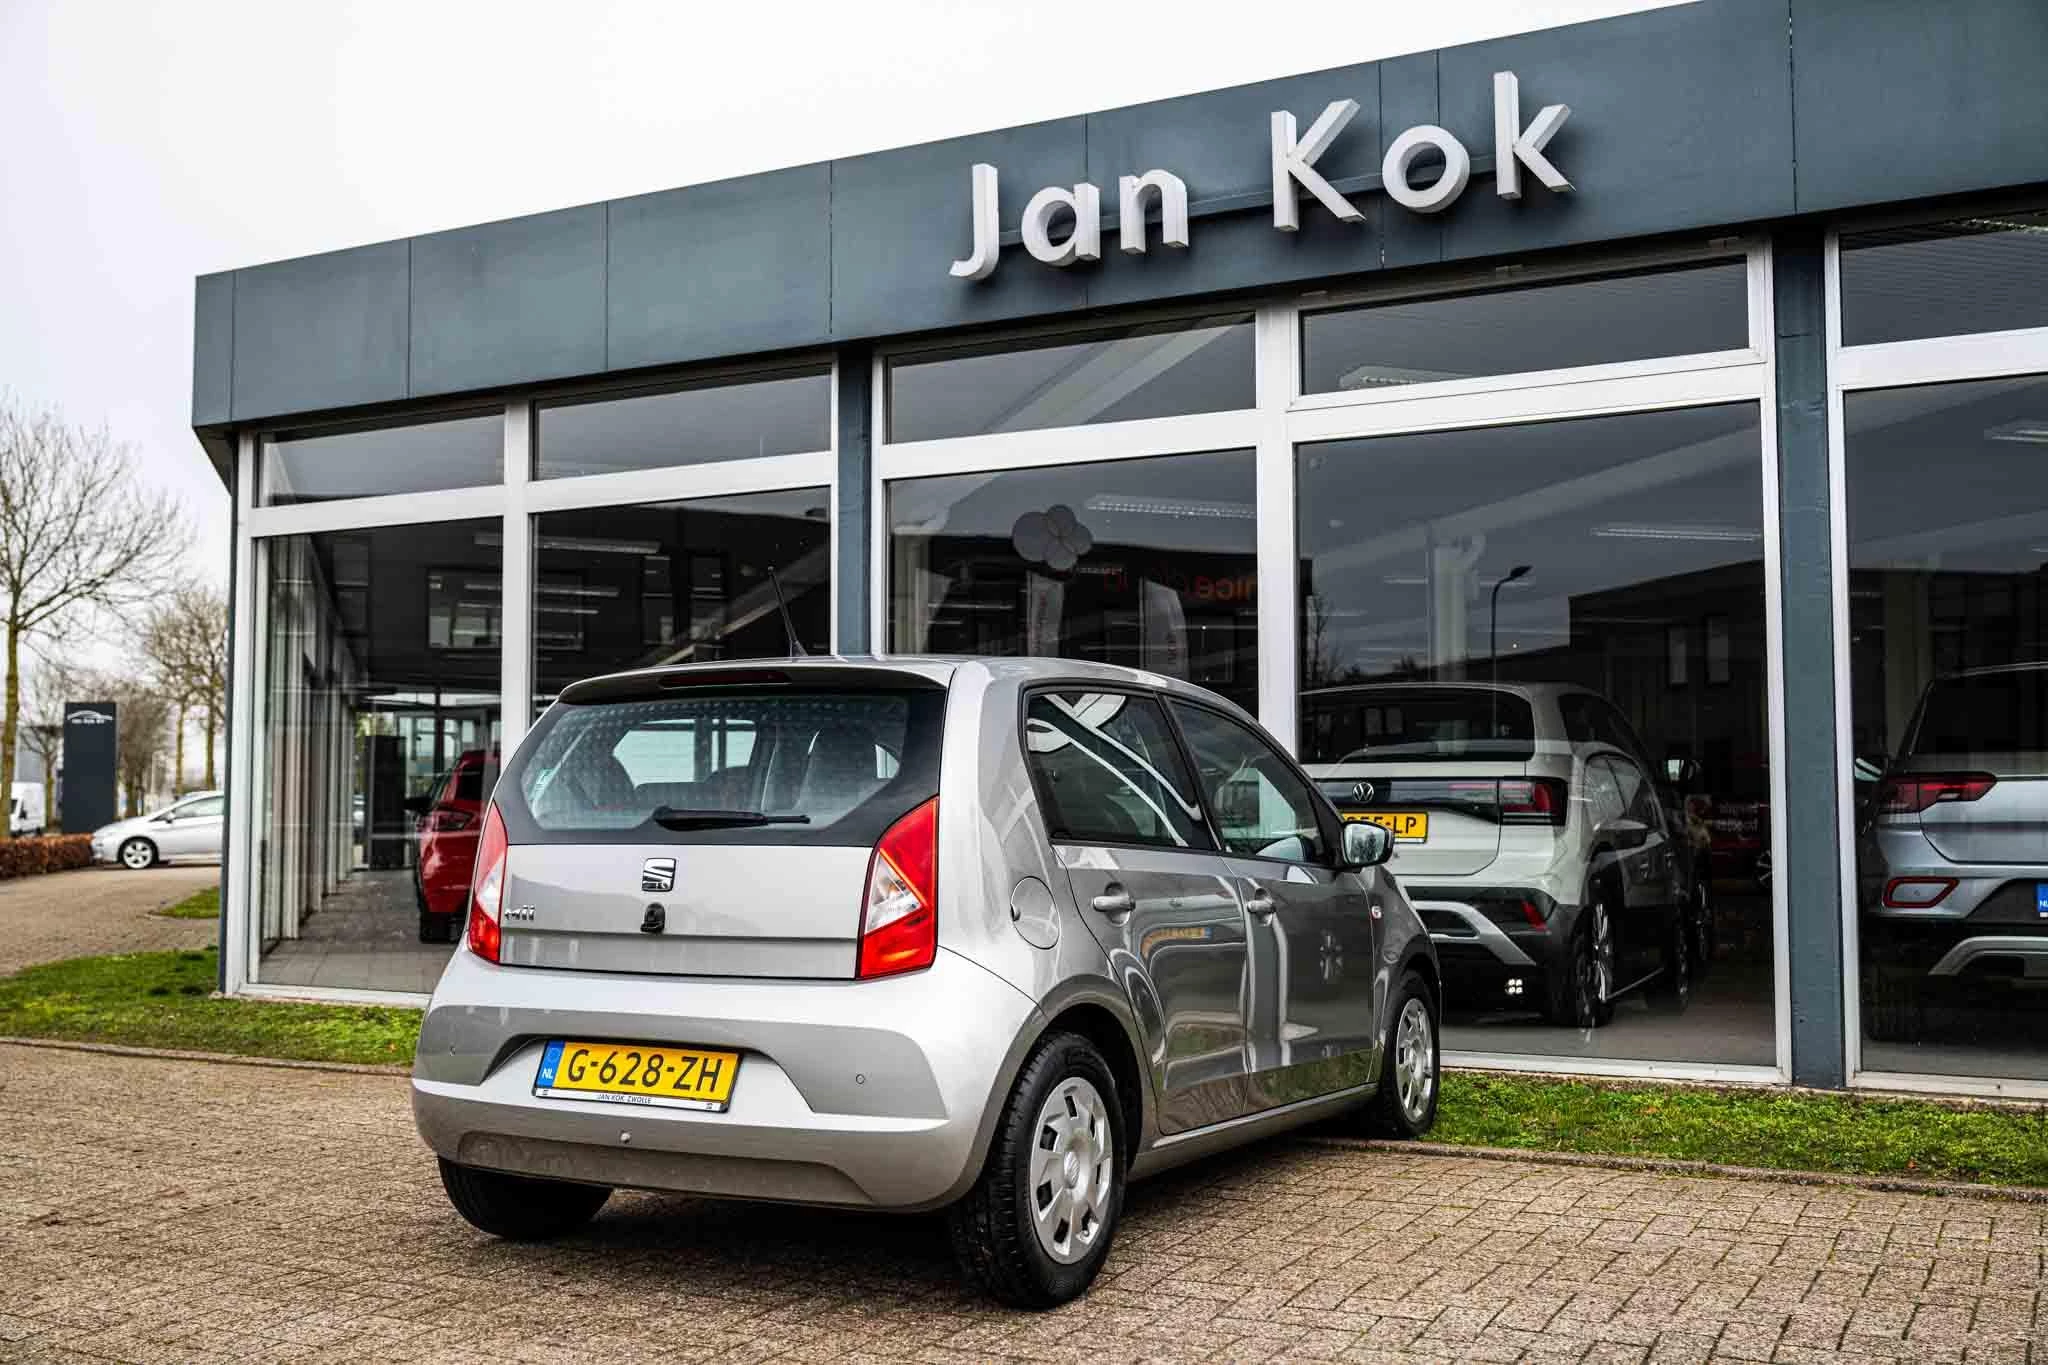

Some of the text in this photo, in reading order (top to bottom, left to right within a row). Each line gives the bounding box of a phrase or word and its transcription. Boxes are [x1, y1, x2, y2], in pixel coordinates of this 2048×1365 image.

[949, 71, 1575, 281] Jan Kok
[541, 1067, 554, 1079] NL
[568, 1049, 722, 1092] G-628-ZH
